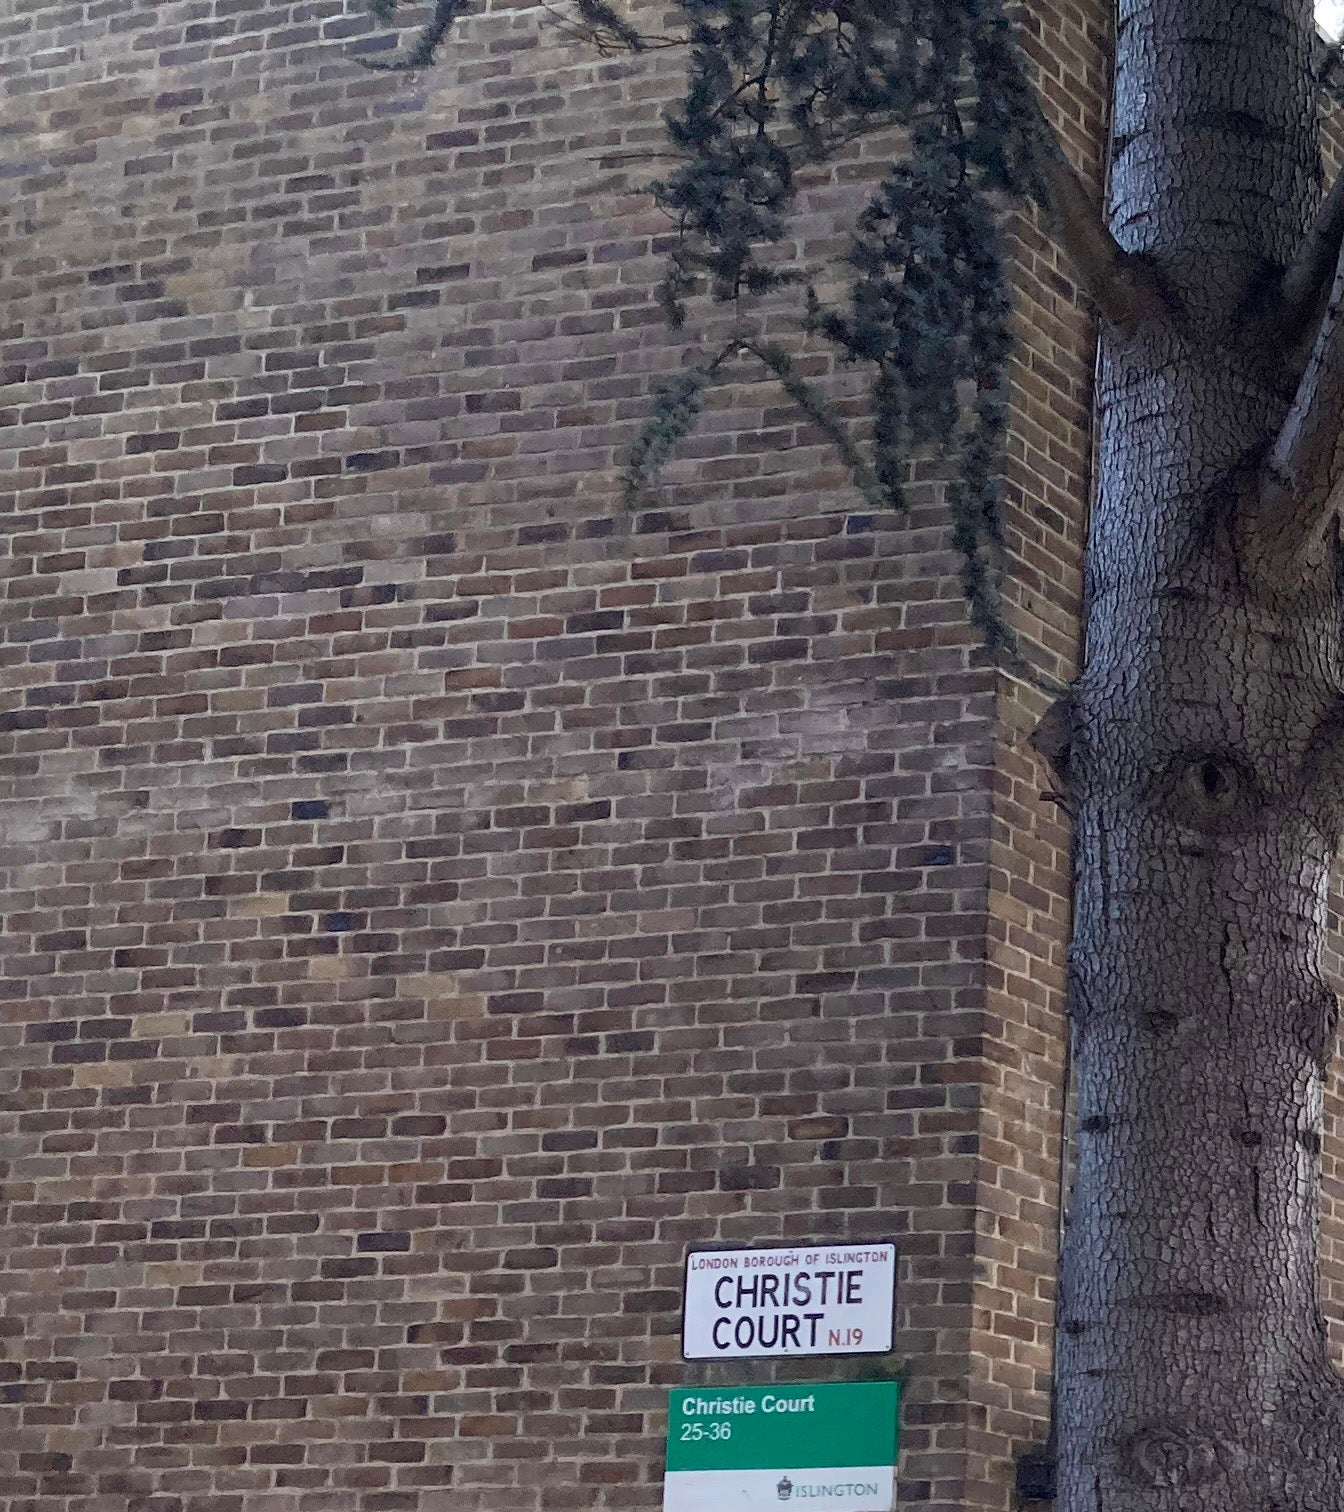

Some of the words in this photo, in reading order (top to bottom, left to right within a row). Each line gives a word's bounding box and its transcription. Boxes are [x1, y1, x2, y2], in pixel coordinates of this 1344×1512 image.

[691, 1257, 738, 1270] LONDON
[744, 1254, 799, 1268] BOROUGH
[805, 1253, 819, 1265] OF
[825, 1251, 888, 1264] ISLINGTON
[714, 1270, 863, 1308] CHRISTIE
[712, 1313, 825, 1350] COURT
[828, 1328, 863, 1346] N.19
[682, 1396, 756, 1416] Christie
[761, 1395, 815, 1413] Court
[680, 1422, 731, 1441] 25-36
[795, 1483, 878, 1498] ISLINGTON
